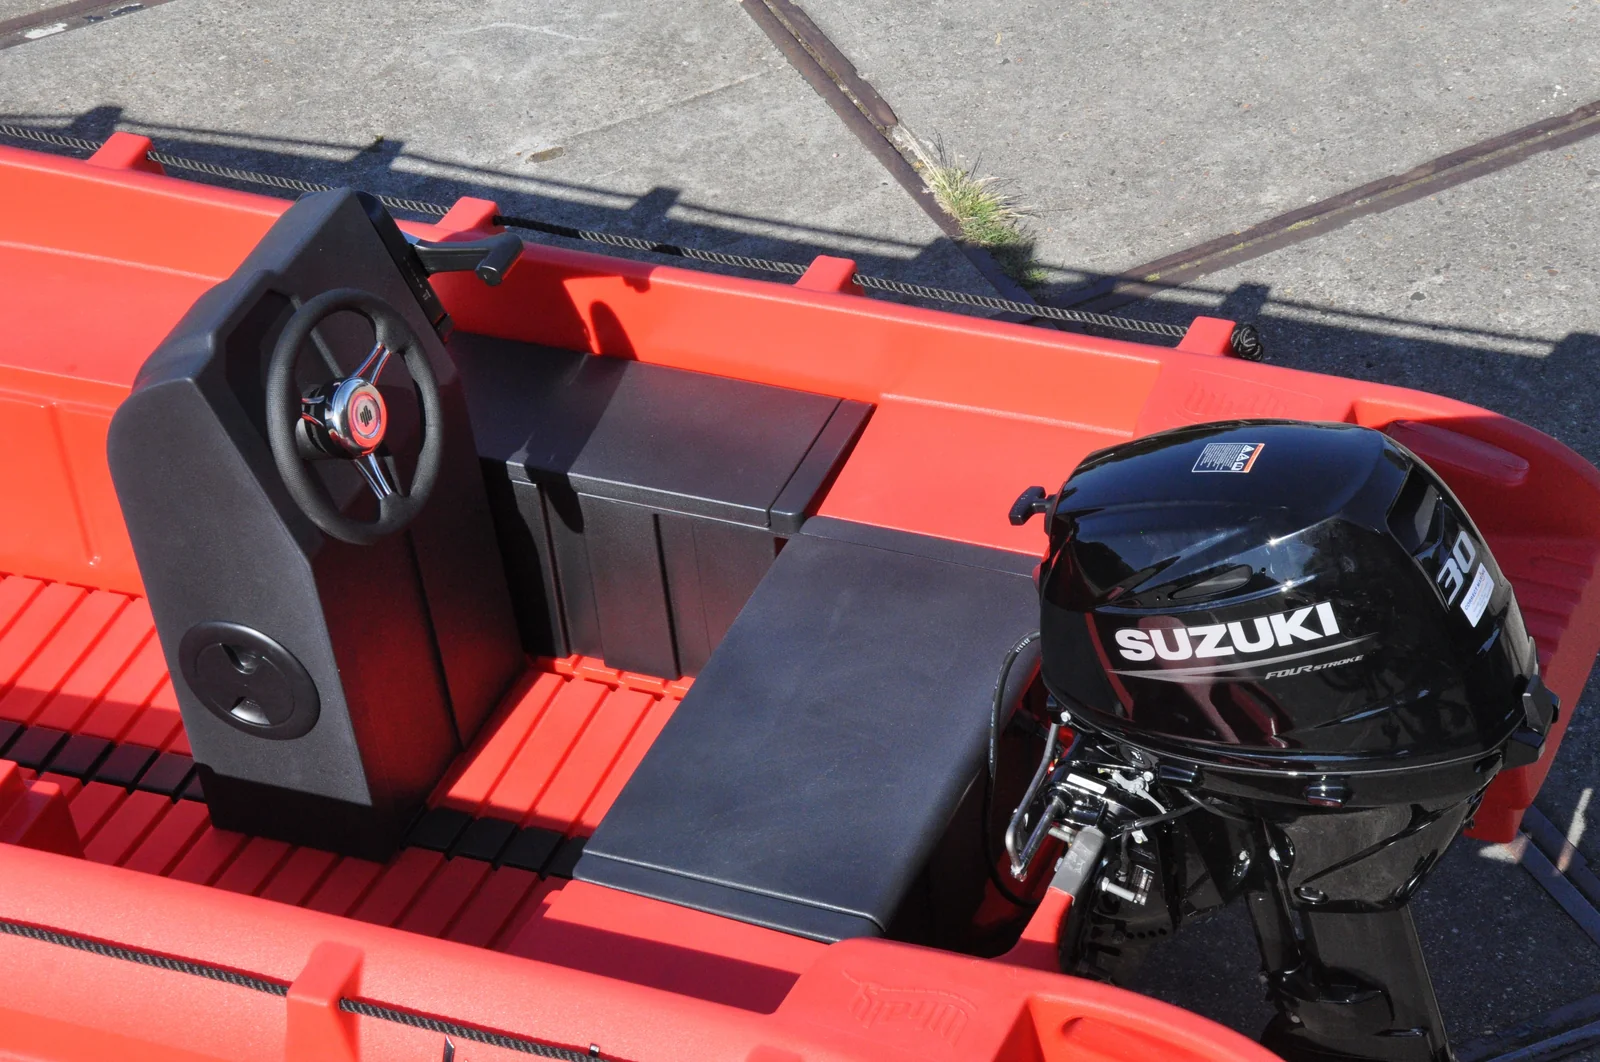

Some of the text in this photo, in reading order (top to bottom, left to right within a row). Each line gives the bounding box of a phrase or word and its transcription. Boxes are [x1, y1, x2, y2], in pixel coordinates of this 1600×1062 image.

[1437, 530, 1476, 606] 30
[1115, 601, 1340, 662] SUZUKI
[1264, 654, 1365, 680] FOUR STROKE
